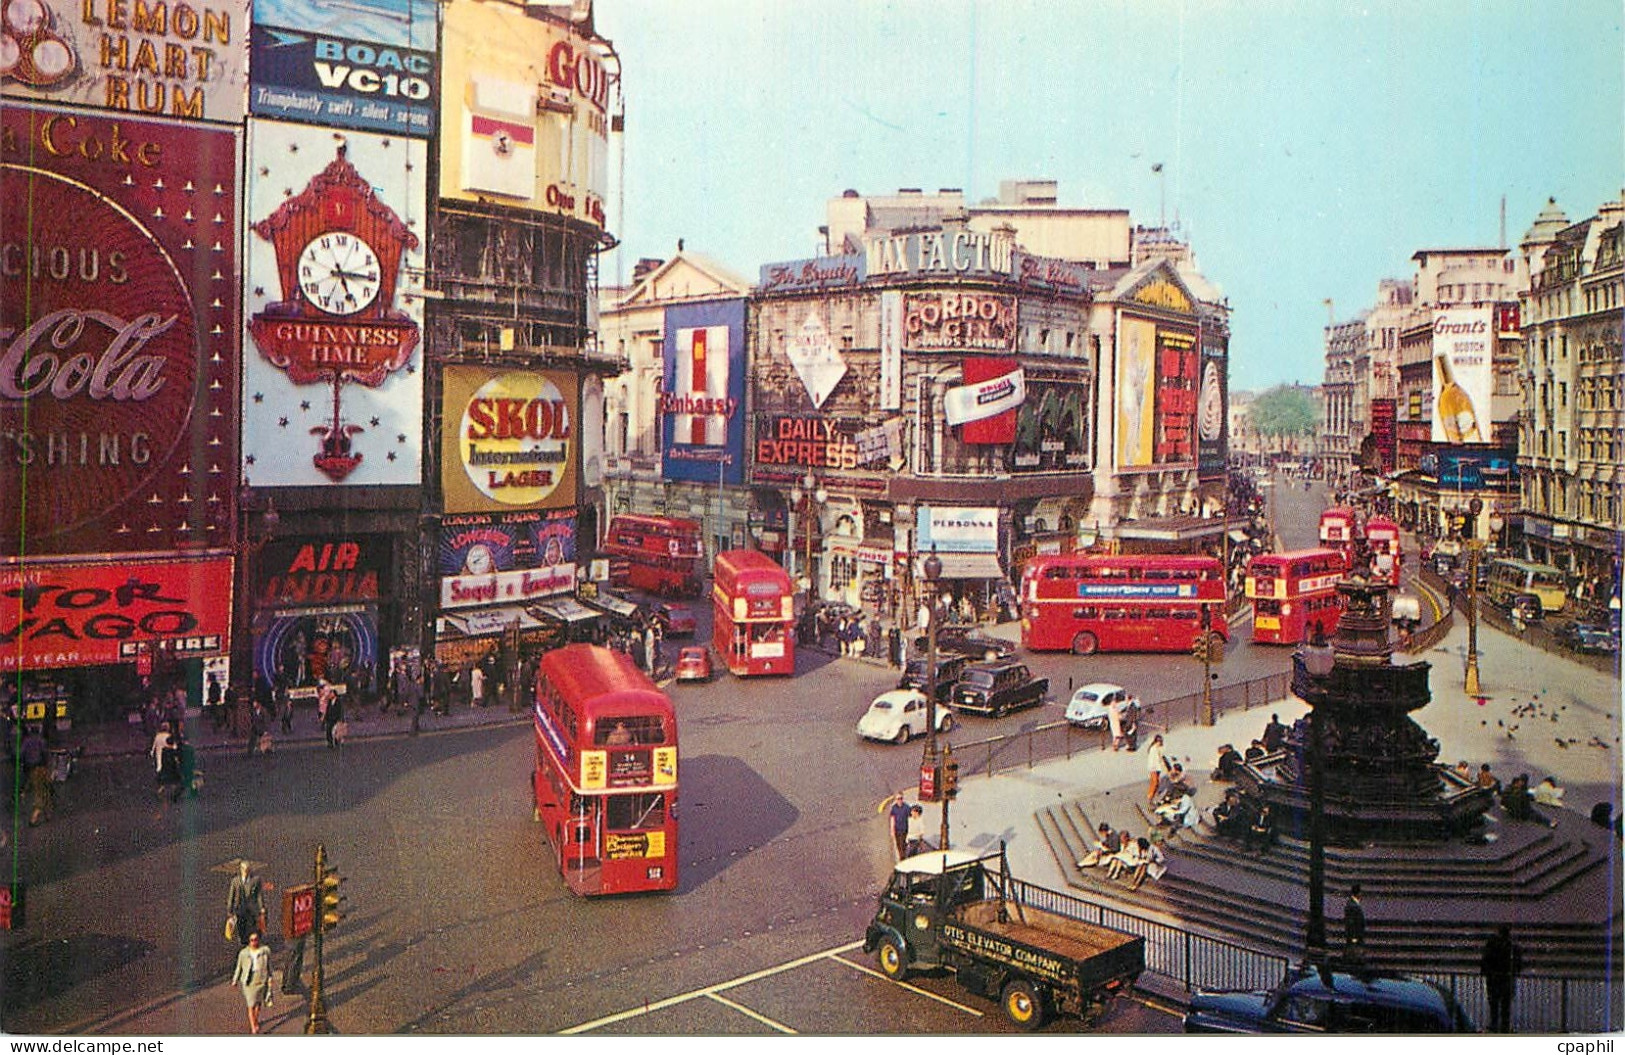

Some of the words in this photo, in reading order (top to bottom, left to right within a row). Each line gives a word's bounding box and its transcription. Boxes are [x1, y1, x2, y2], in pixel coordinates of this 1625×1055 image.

[82, 0, 230, 45] LEMON
[99, 33, 216, 81] HART
[315, 38, 432, 74] BOAC
[313, 61, 431, 100] VC10
[105, 75, 205, 119] RUM
[257, 87, 324, 115] Triumphantly
[328, 101, 354, 117] swift
[360, 103, 390, 121] silent
[41, 114, 161, 168] Coke
[277, 323, 400, 346] GUINNESS
[945, 320, 990, 337] GIN
[1434, 316, 1486, 334] Grant's
[311, 344, 367, 363] TIME
[1454, 341, 1485, 352] SCOTCH
[468, 397, 571, 440] SKOL
[660, 391, 738, 420] Embassy
[779, 418, 836, 441] DAILY
[469, 442, 567, 467] International
[758, 439, 857, 469] EXPRESS
[489, 470, 553, 488] LAGER
[933, 519, 994, 529] PERSONNA
[289, 542, 361, 573] AIR
[4, 576, 187, 613] TOR
[264, 570, 379, 605] INDIA
[33, 651, 79, 664] YEAR
[294, 895, 313, 913] NO
[944, 924, 965, 940] OTIS
[968, 932, 1012, 957] ELEVATOR
[1015, 949, 1062, 974] COMPANY
